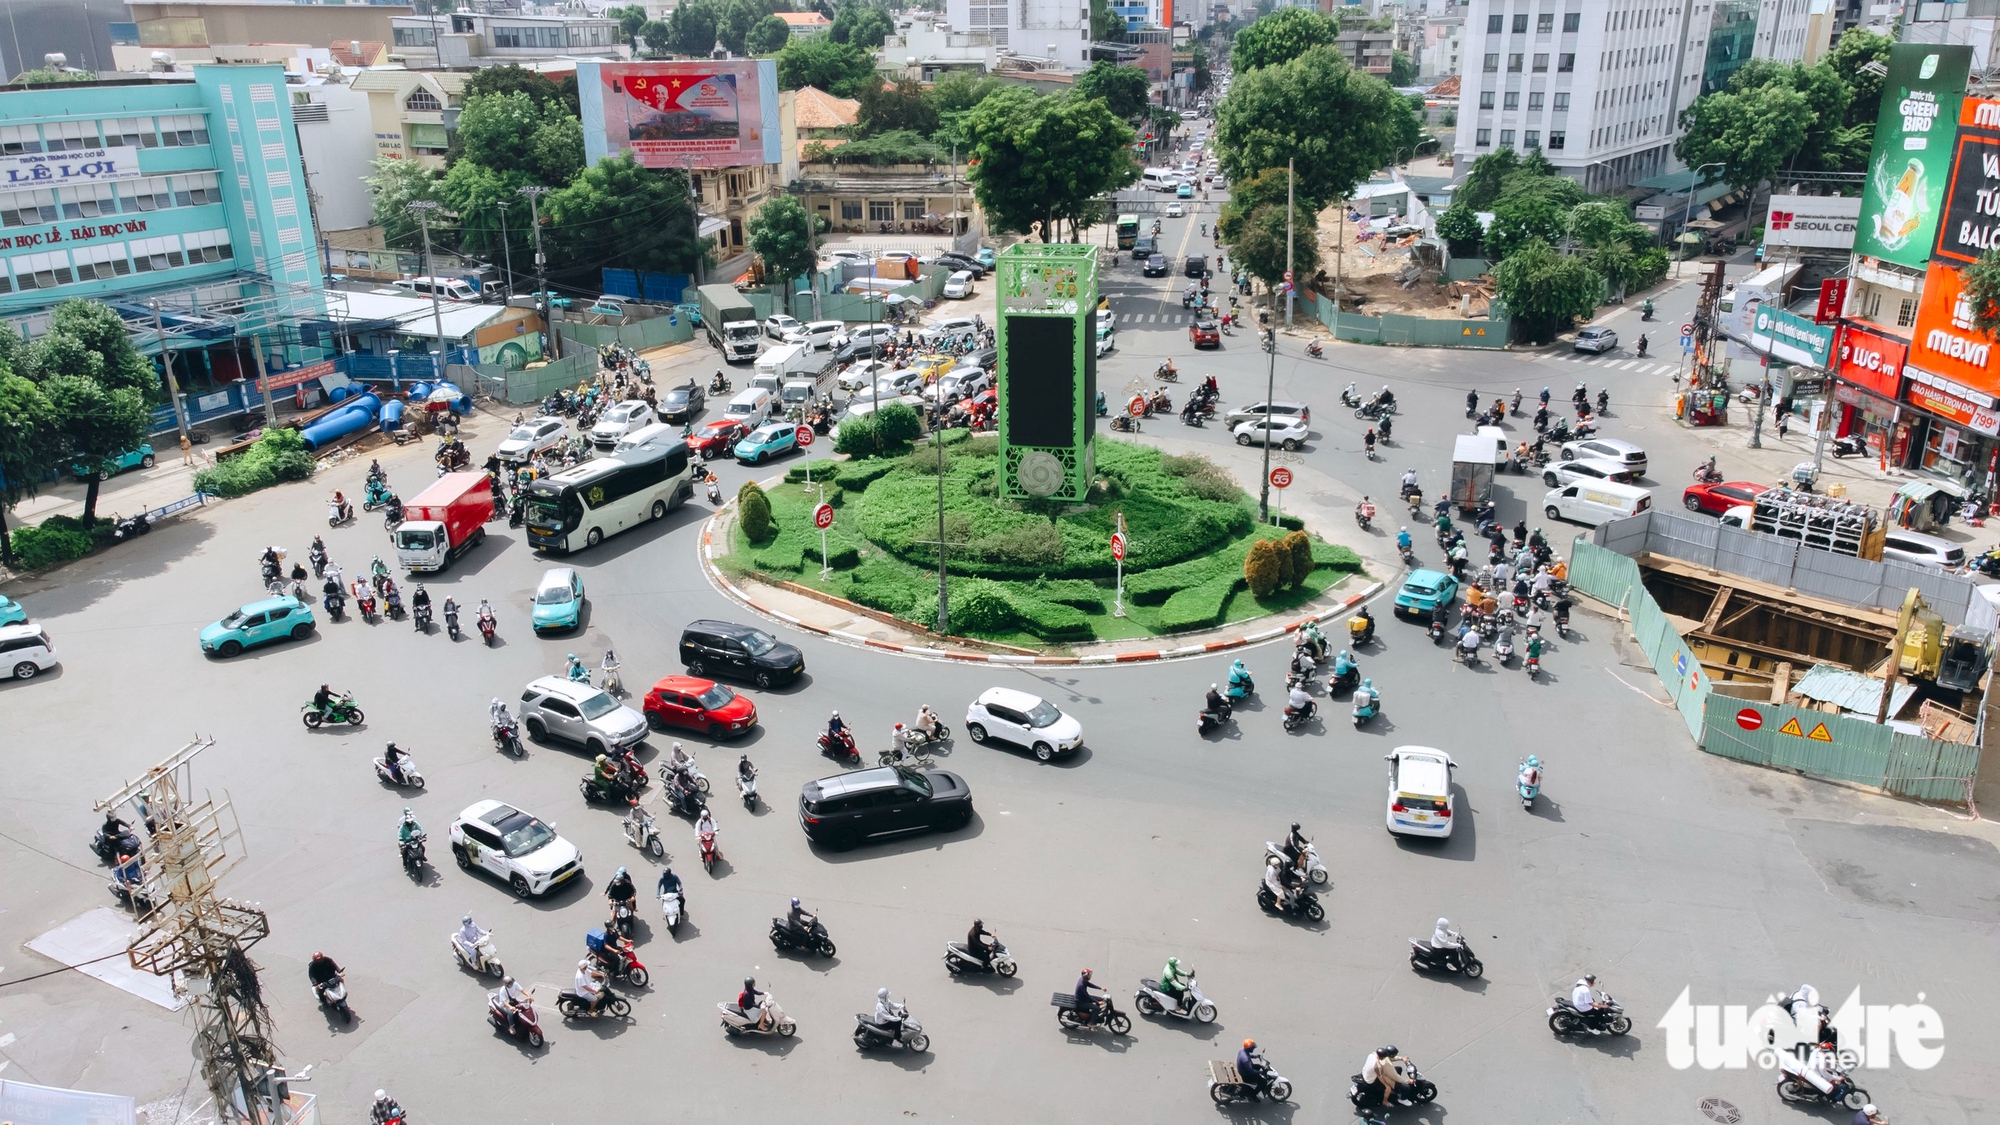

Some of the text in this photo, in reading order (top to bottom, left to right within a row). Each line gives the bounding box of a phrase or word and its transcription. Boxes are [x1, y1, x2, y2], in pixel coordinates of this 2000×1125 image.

[1899, 99, 1939, 117] GREEN
[1902, 116, 1932, 132] BIRD
[47, 154, 67, 162] TRUNG
[68, 152, 84, 160] HỌC
[6, 161, 117, 183] LÊ LỢI
[14, 233, 42, 249] HỌC
[45, 226, 62, 244] LỄ
[70, 225, 97, 241] HẬU
[99, 223, 123, 238] HỌC
[123, 219, 147, 233] VĂN
[1794, 222, 1832, 231] SEOUL
[1926, 329, 1988, 368] mia.vn
[1911, 383, 1924, 394] BẢO
[1925, 388, 1944, 402] HÀNH
[1944, 396, 1961, 410] TRỌN
[1961, 403, 1975, 415] ĐỜI
[798, 433, 811, 443] 5G
[1273, 474, 1289, 485] 5G
[819, 511, 832, 525] 5G
[1112, 542, 1121, 556] 5G
